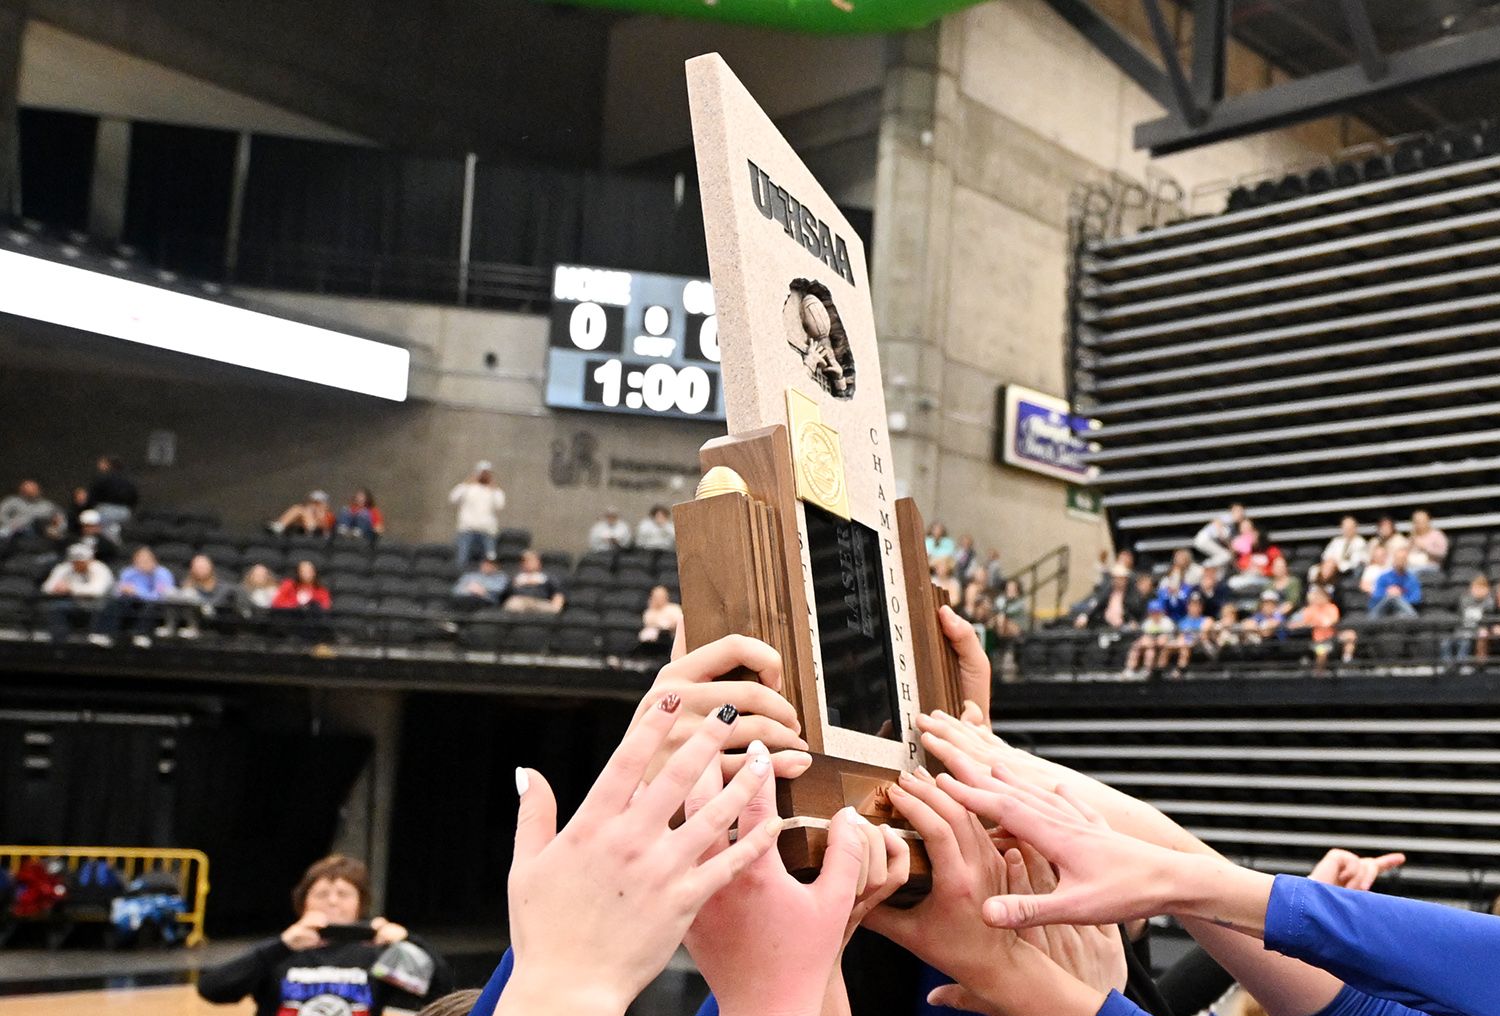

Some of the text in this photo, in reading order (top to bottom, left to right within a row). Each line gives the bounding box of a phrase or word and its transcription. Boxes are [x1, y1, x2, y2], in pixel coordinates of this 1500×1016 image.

[570, 302, 607, 350] 0
[593, 359, 711, 414] 1:00
[869, 427, 918, 760] CHAMPIONSHIP
